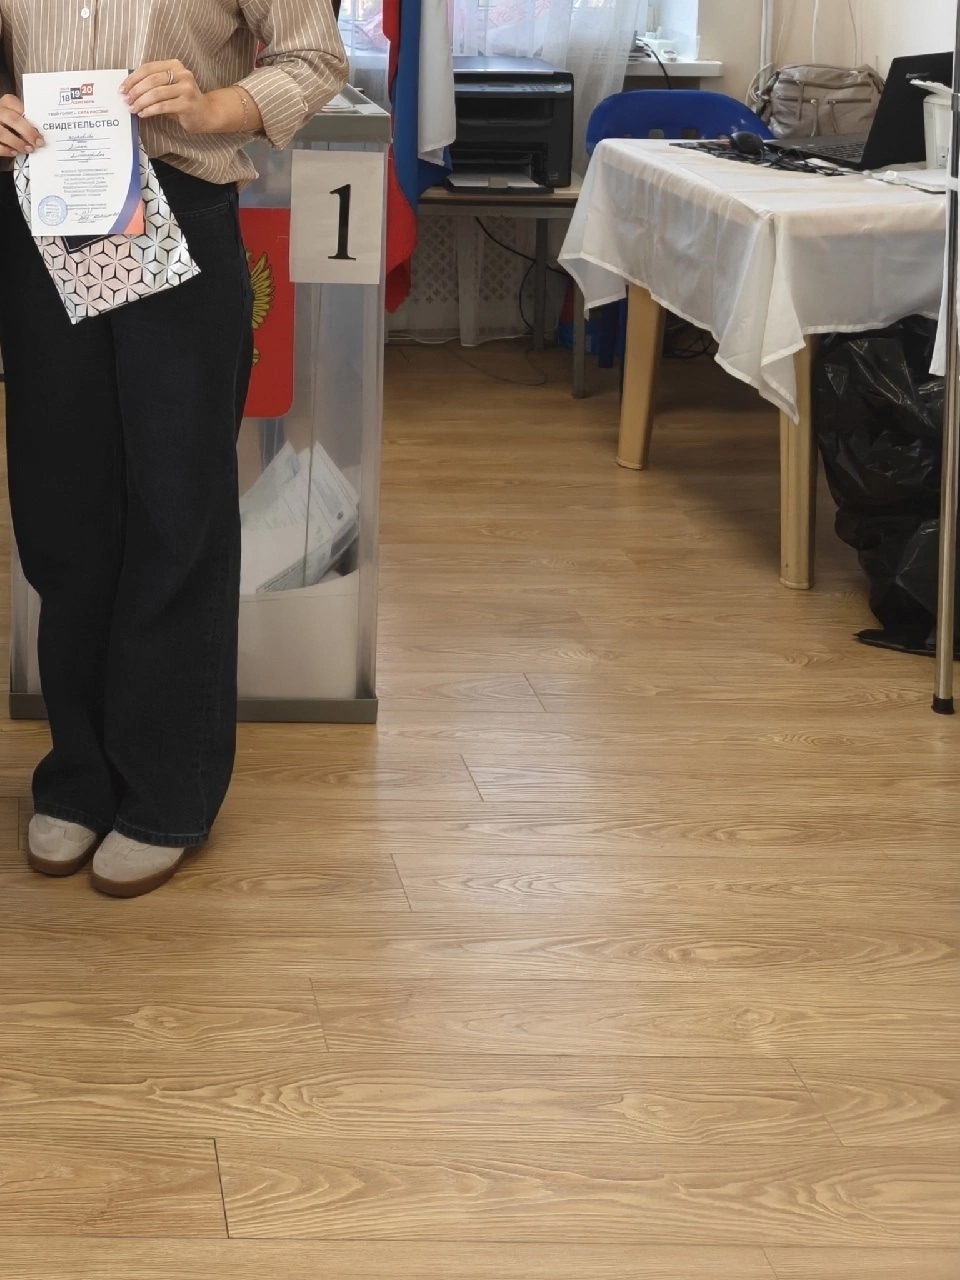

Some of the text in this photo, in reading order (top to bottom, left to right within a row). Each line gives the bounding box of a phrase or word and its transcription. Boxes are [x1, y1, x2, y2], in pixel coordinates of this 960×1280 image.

[61, 86, 93, 102] 18 19 20
[42, 119, 120, 131] СВИДЕТЕЛЬСТВО
[327, 183, 357, 261] 1
